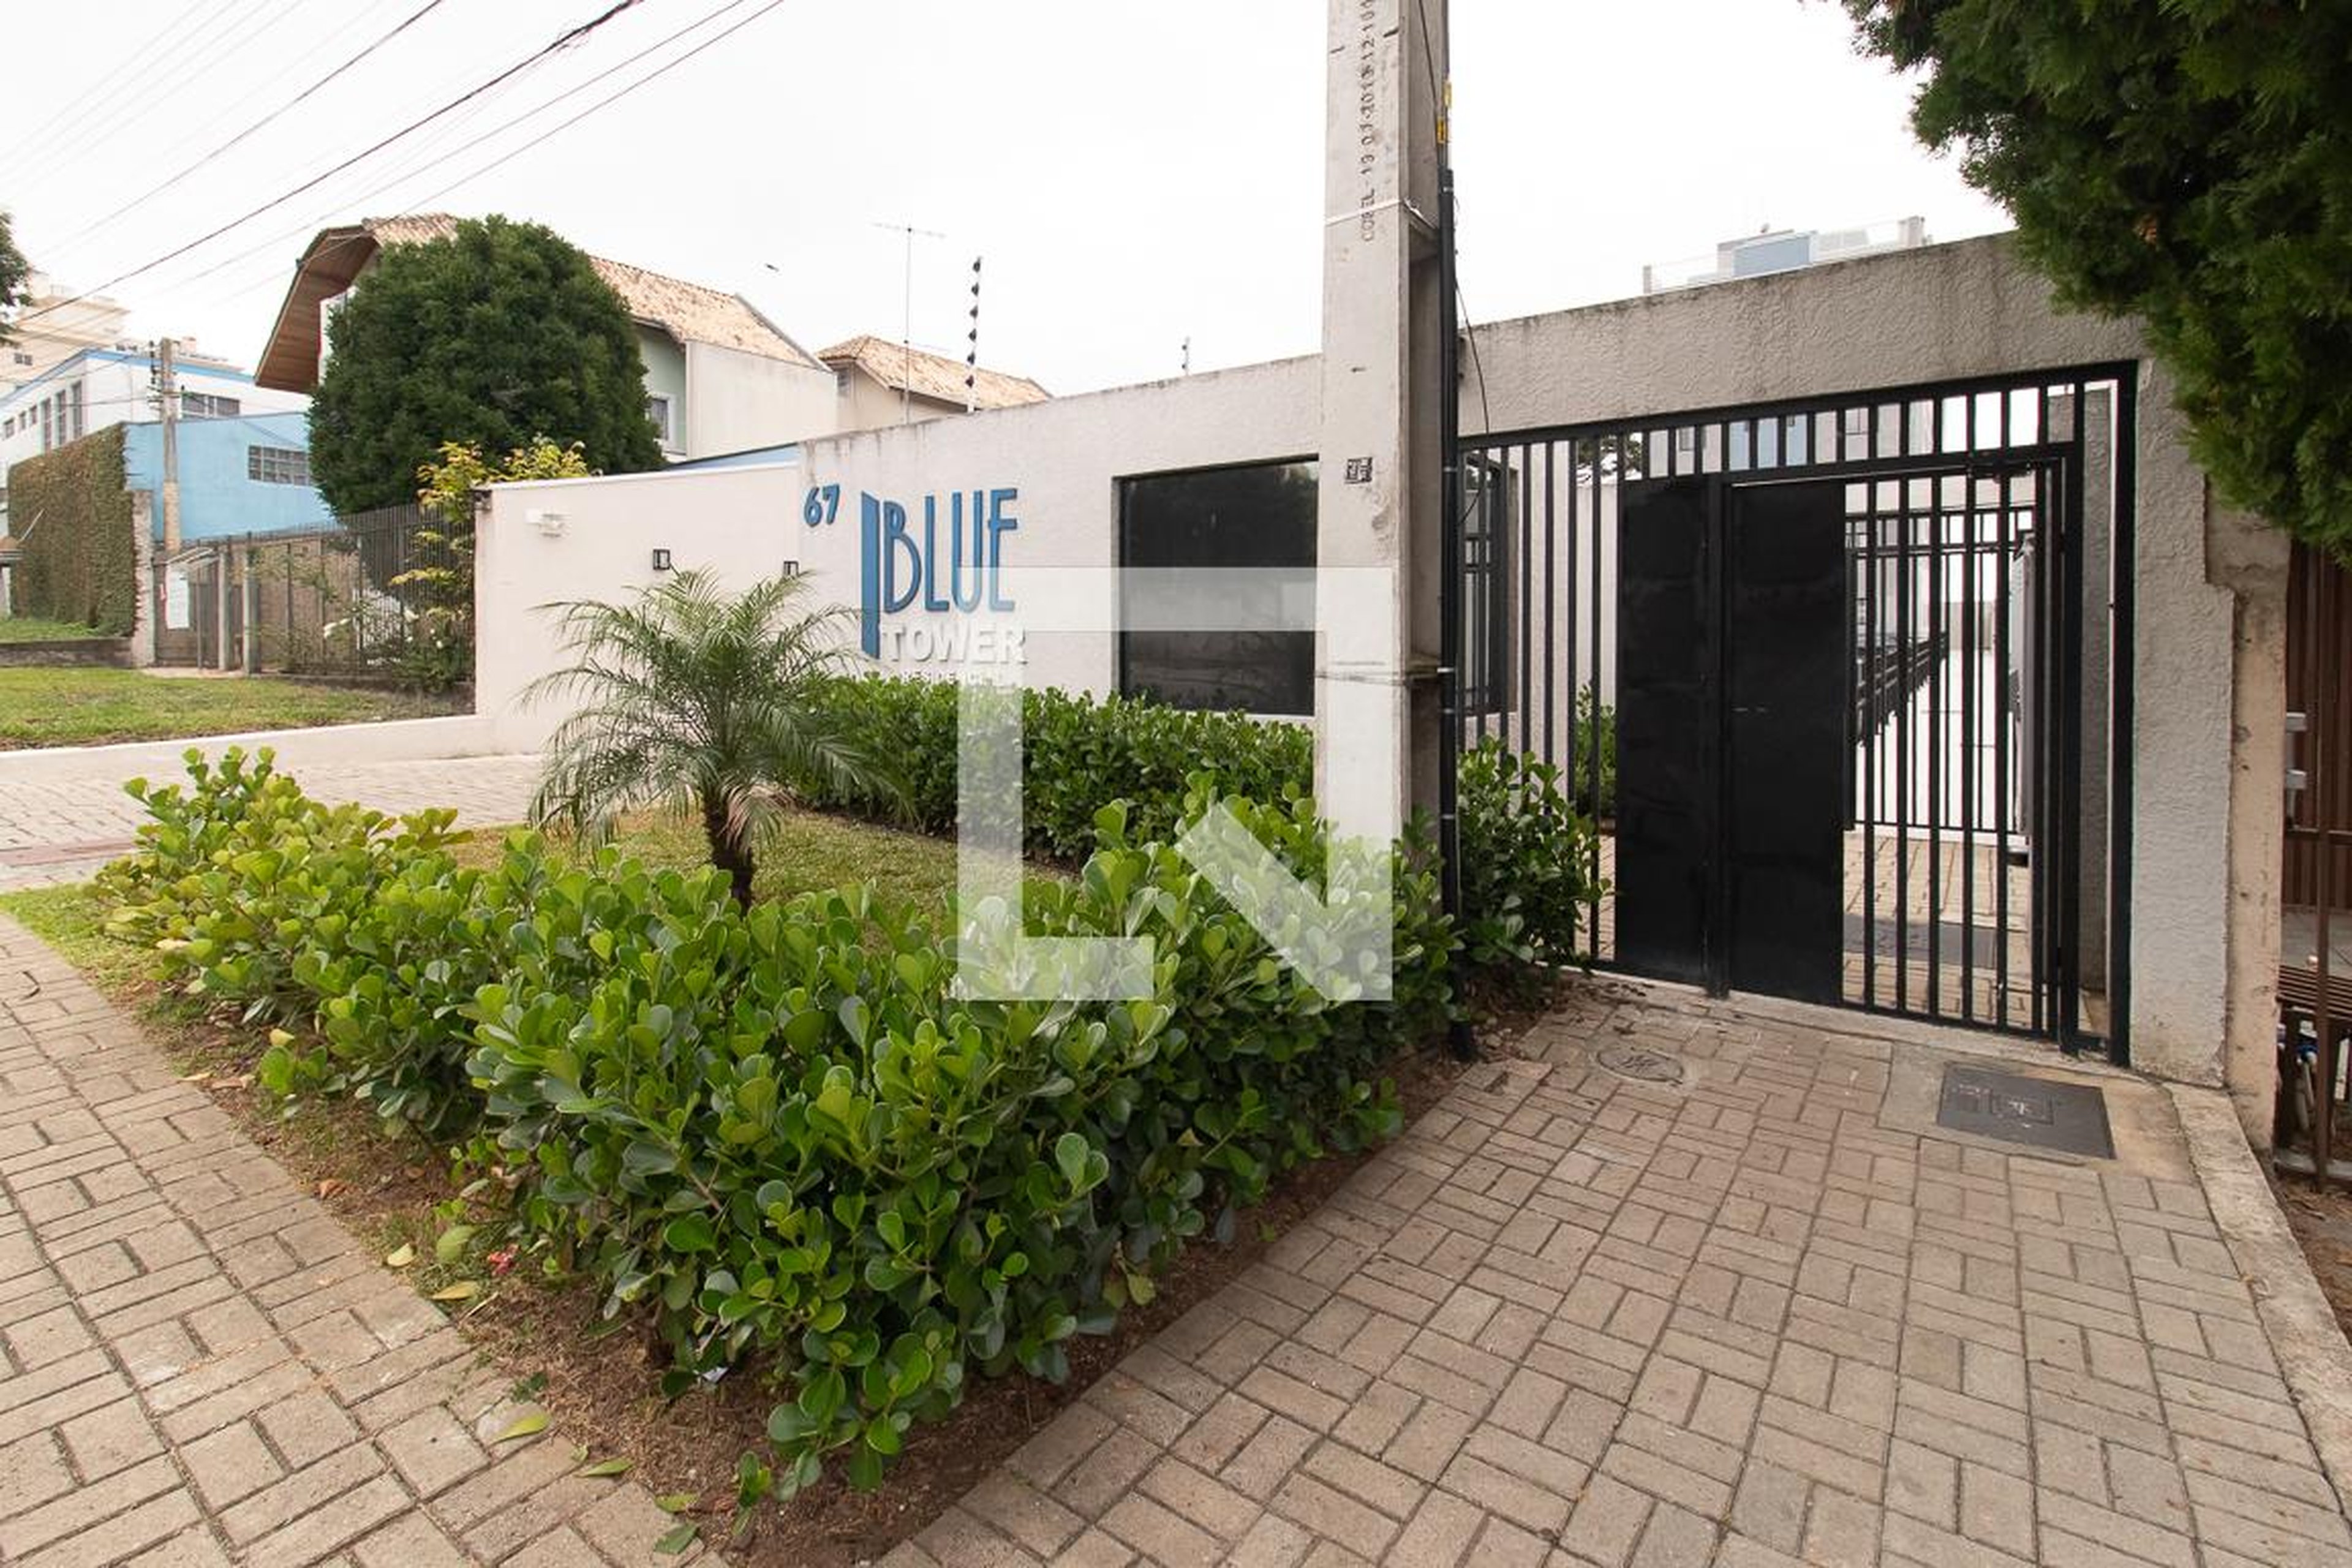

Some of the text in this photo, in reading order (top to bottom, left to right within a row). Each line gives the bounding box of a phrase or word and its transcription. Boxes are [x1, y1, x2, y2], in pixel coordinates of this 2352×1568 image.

[804, 483, 840, 527] 67
[883, 488, 1018, 614] BLUE
[880, 621, 1028, 665] TOWER
